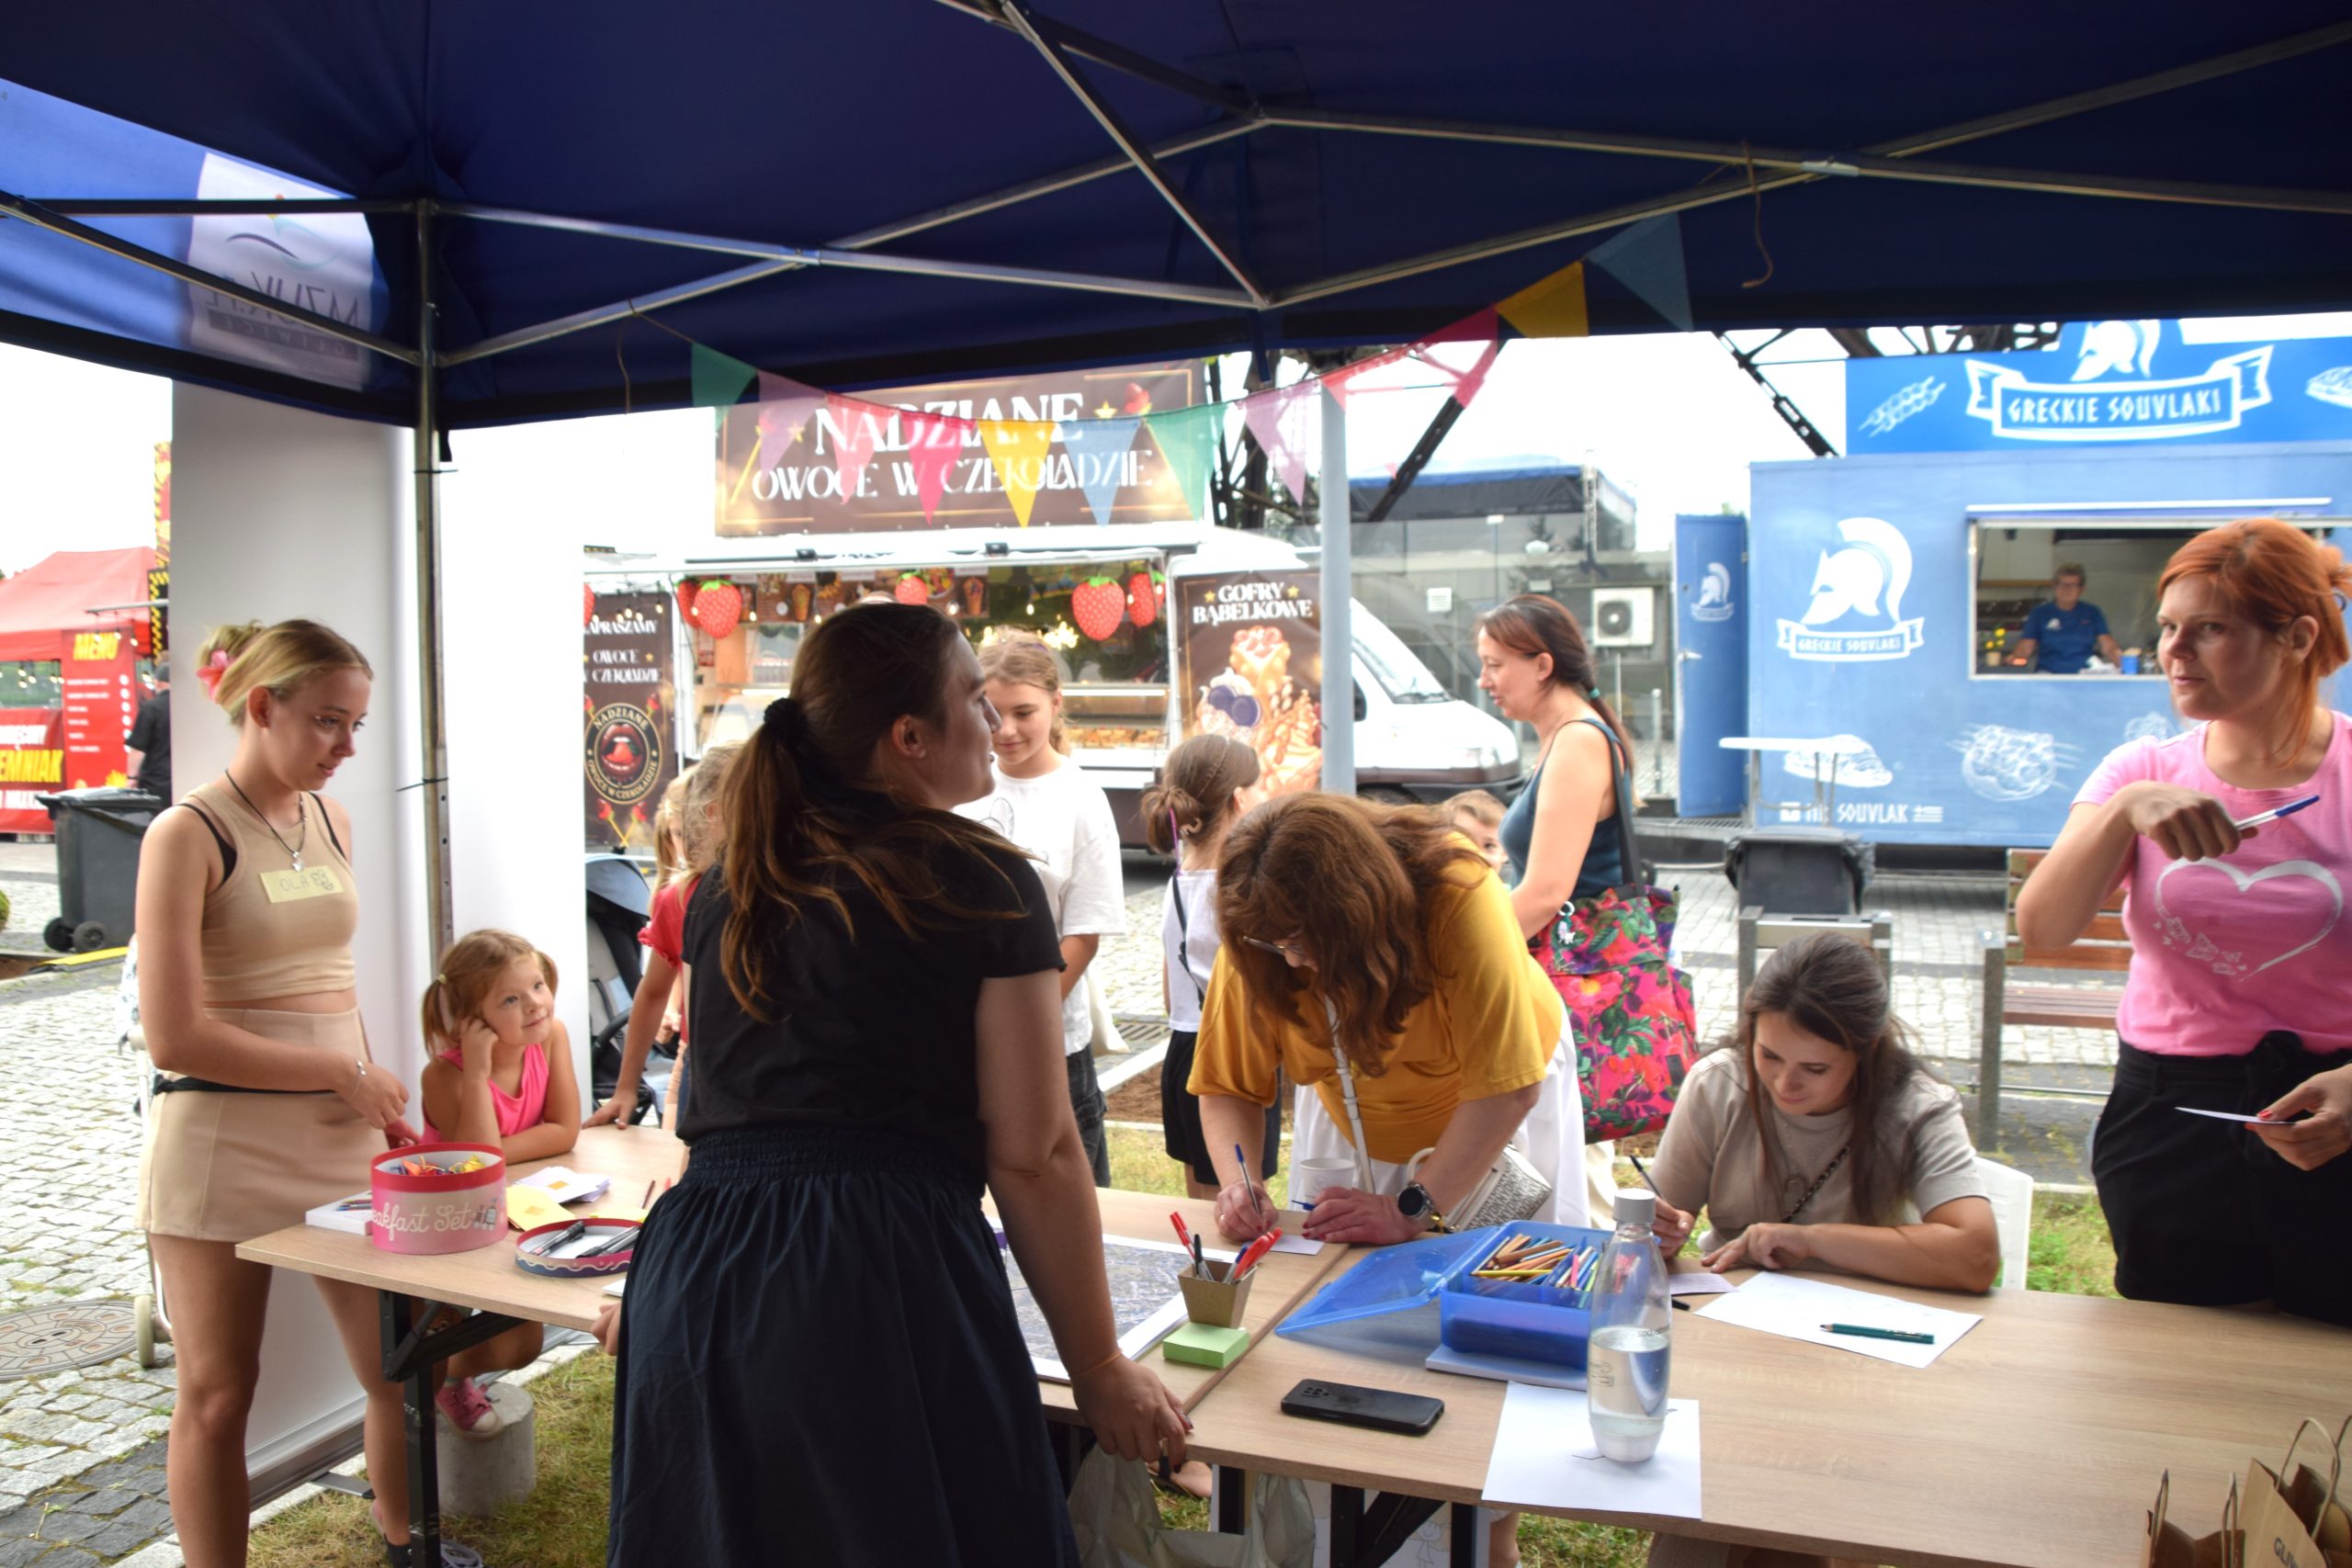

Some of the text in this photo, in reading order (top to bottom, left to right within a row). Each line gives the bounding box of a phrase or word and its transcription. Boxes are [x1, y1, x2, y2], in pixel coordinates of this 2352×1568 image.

[2007, 388, 2222, 423] GRECKIE SOUVLAKI
[752, 449, 1153, 502] OWOCE W CZEKOLADZIE
[1217, 581, 1285, 604] GOFRY
[1193, 599, 1313, 626] BĄBELKOWE
[73, 632, 119, 660] MENU
[593, 649, 639, 664] OWOCE
[1798, 637, 1902, 652] GRECKIE SOUVLAKI
[594, 706, 649, 730] NADZIANE
[279, 874, 310, 892] OLA
[434, 1201, 474, 1232] Set
